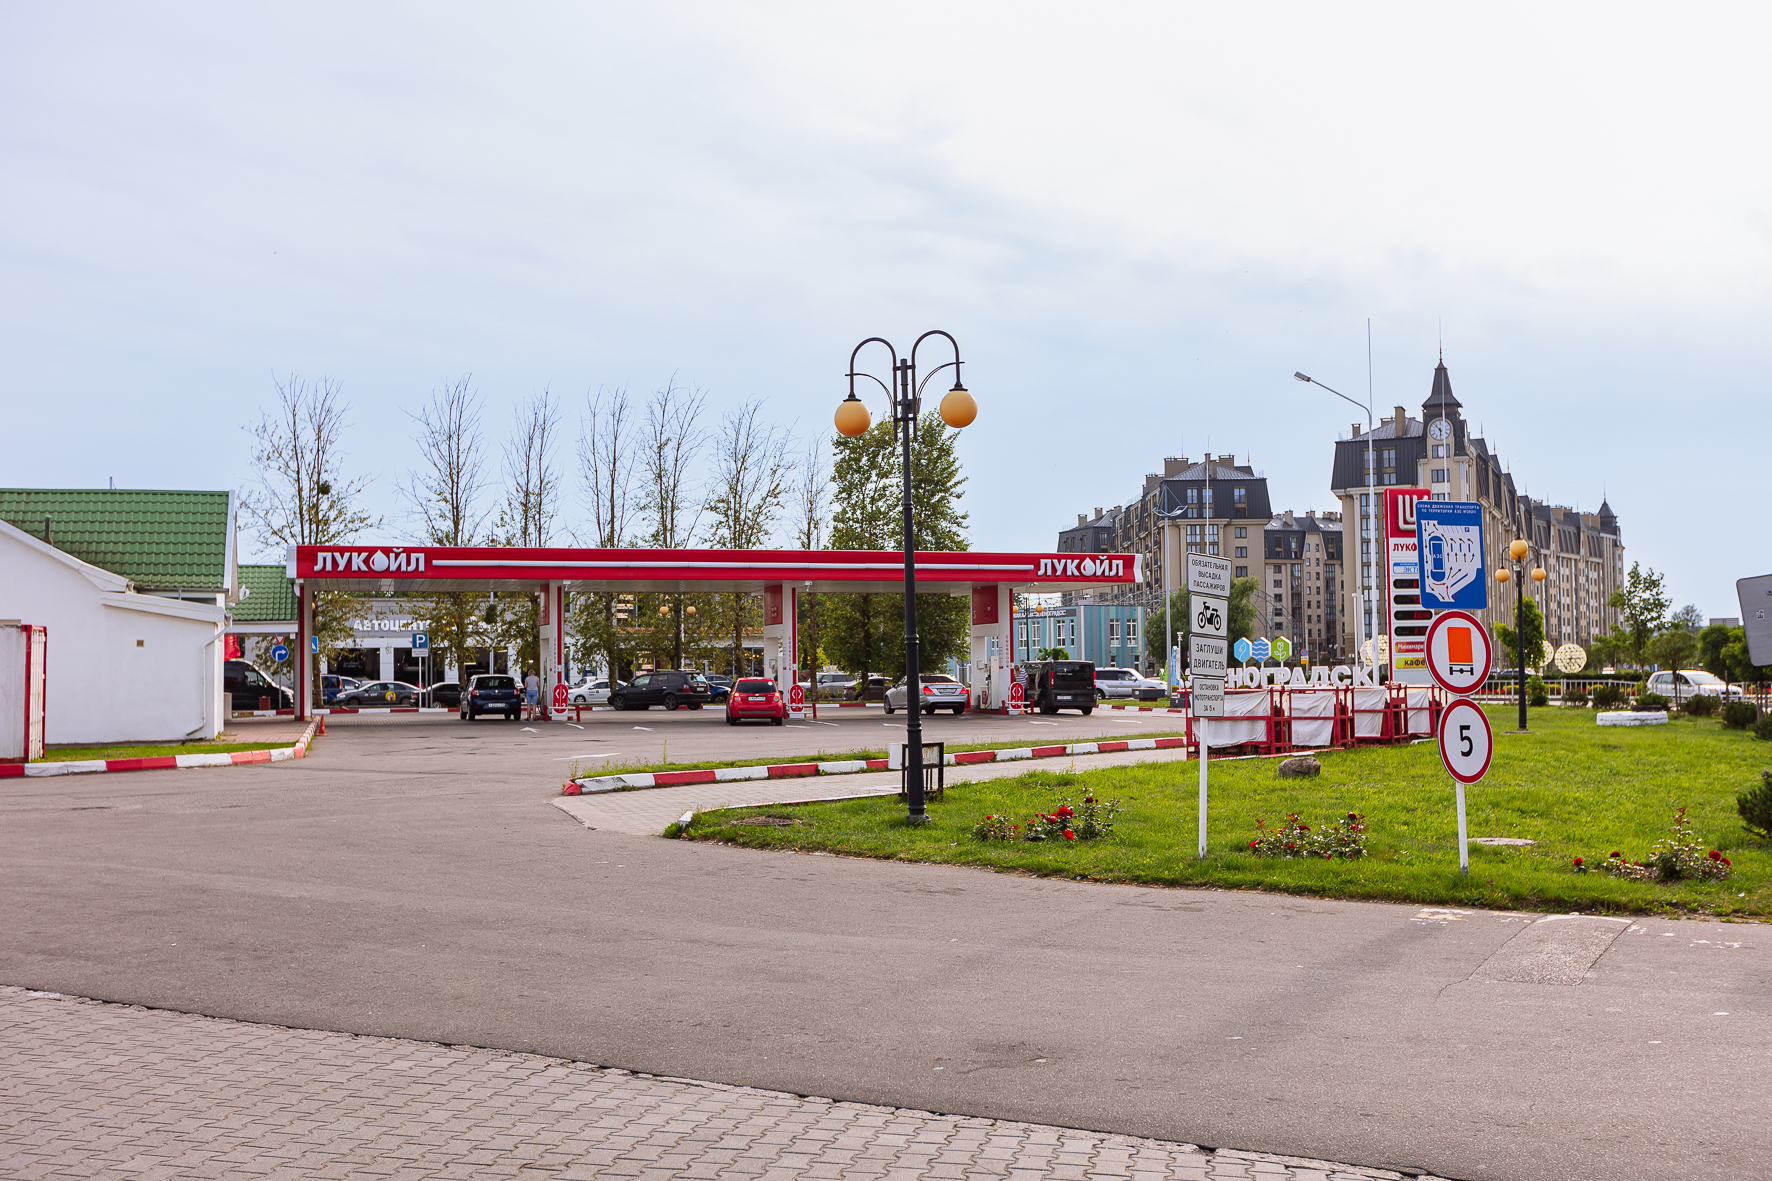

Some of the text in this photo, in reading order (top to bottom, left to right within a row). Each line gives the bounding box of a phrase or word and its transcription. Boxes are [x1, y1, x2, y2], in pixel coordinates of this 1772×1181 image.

[314, 548, 424, 572] ЛУКОЙЛ
[1038, 556, 1123, 576] ЛУКОЙЛ
[1192, 559, 1228, 571] ОБЯЗАТЕЛЬНАЯ
[1198, 571, 1221, 580] ВЫСАДКА
[1193, 580, 1225, 591] ПАССАЖИРОВ
[416, 634, 425, 647] P
[1196, 643, 1223, 655] ЗАГЛУШИ
[1194, 659, 1225, 670] ДВИГАТЕЛЬ
[1459, 725, 1473, 757] 5
